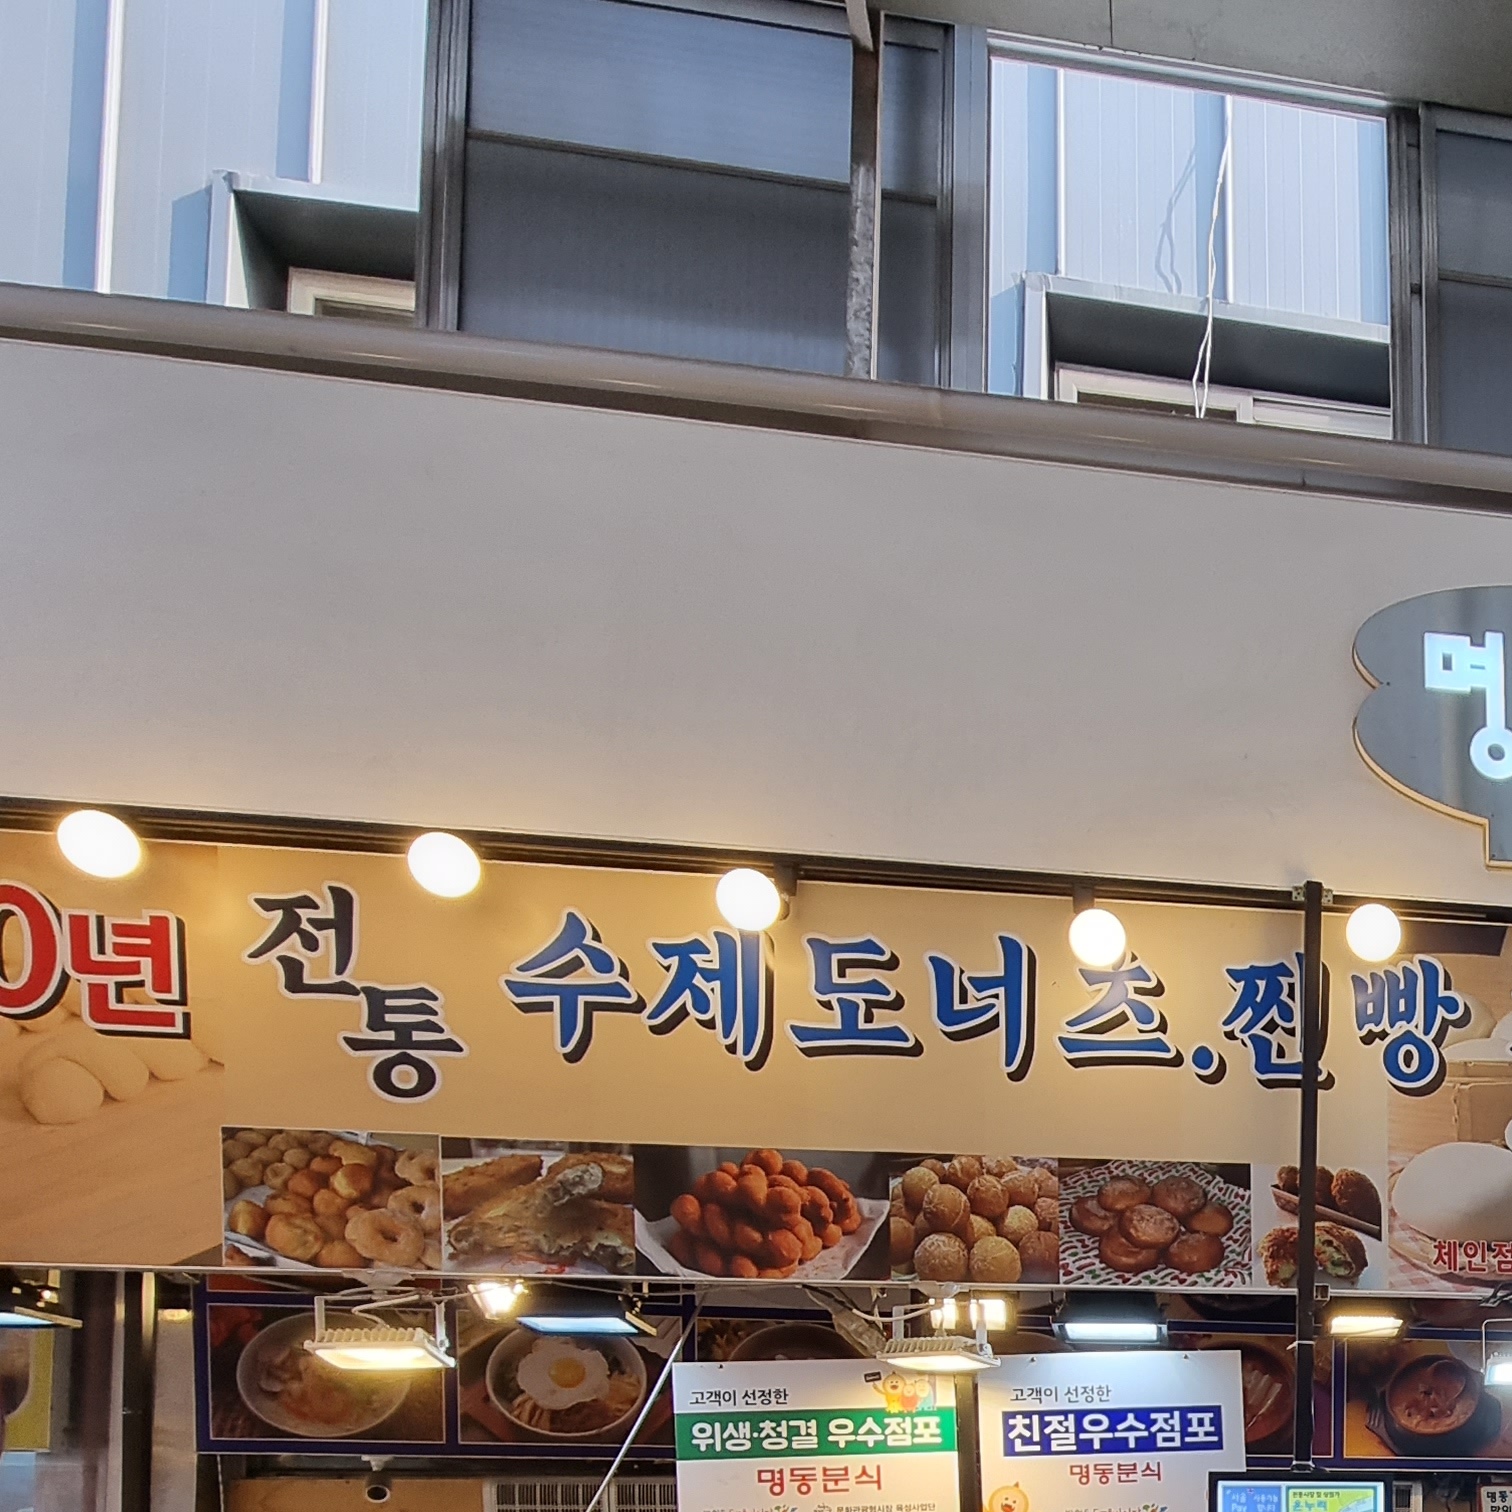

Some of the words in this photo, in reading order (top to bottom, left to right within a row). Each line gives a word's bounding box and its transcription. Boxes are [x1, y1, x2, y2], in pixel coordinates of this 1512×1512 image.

[689, 1390, 737, 1406] 고객이
[742, 1388, 789, 1406] 선정한
[1010, 1387, 1058, 1404] 고객이
[1064, 1385, 1112, 1403] 선정한
[828, 1416, 942, 1448] 우수점포
[1008, 1411, 1219, 1452] 친절우수점포
[757, 1465, 882, 1497] 명동분식
[1070, 1461, 1162, 1486] 명동분식
